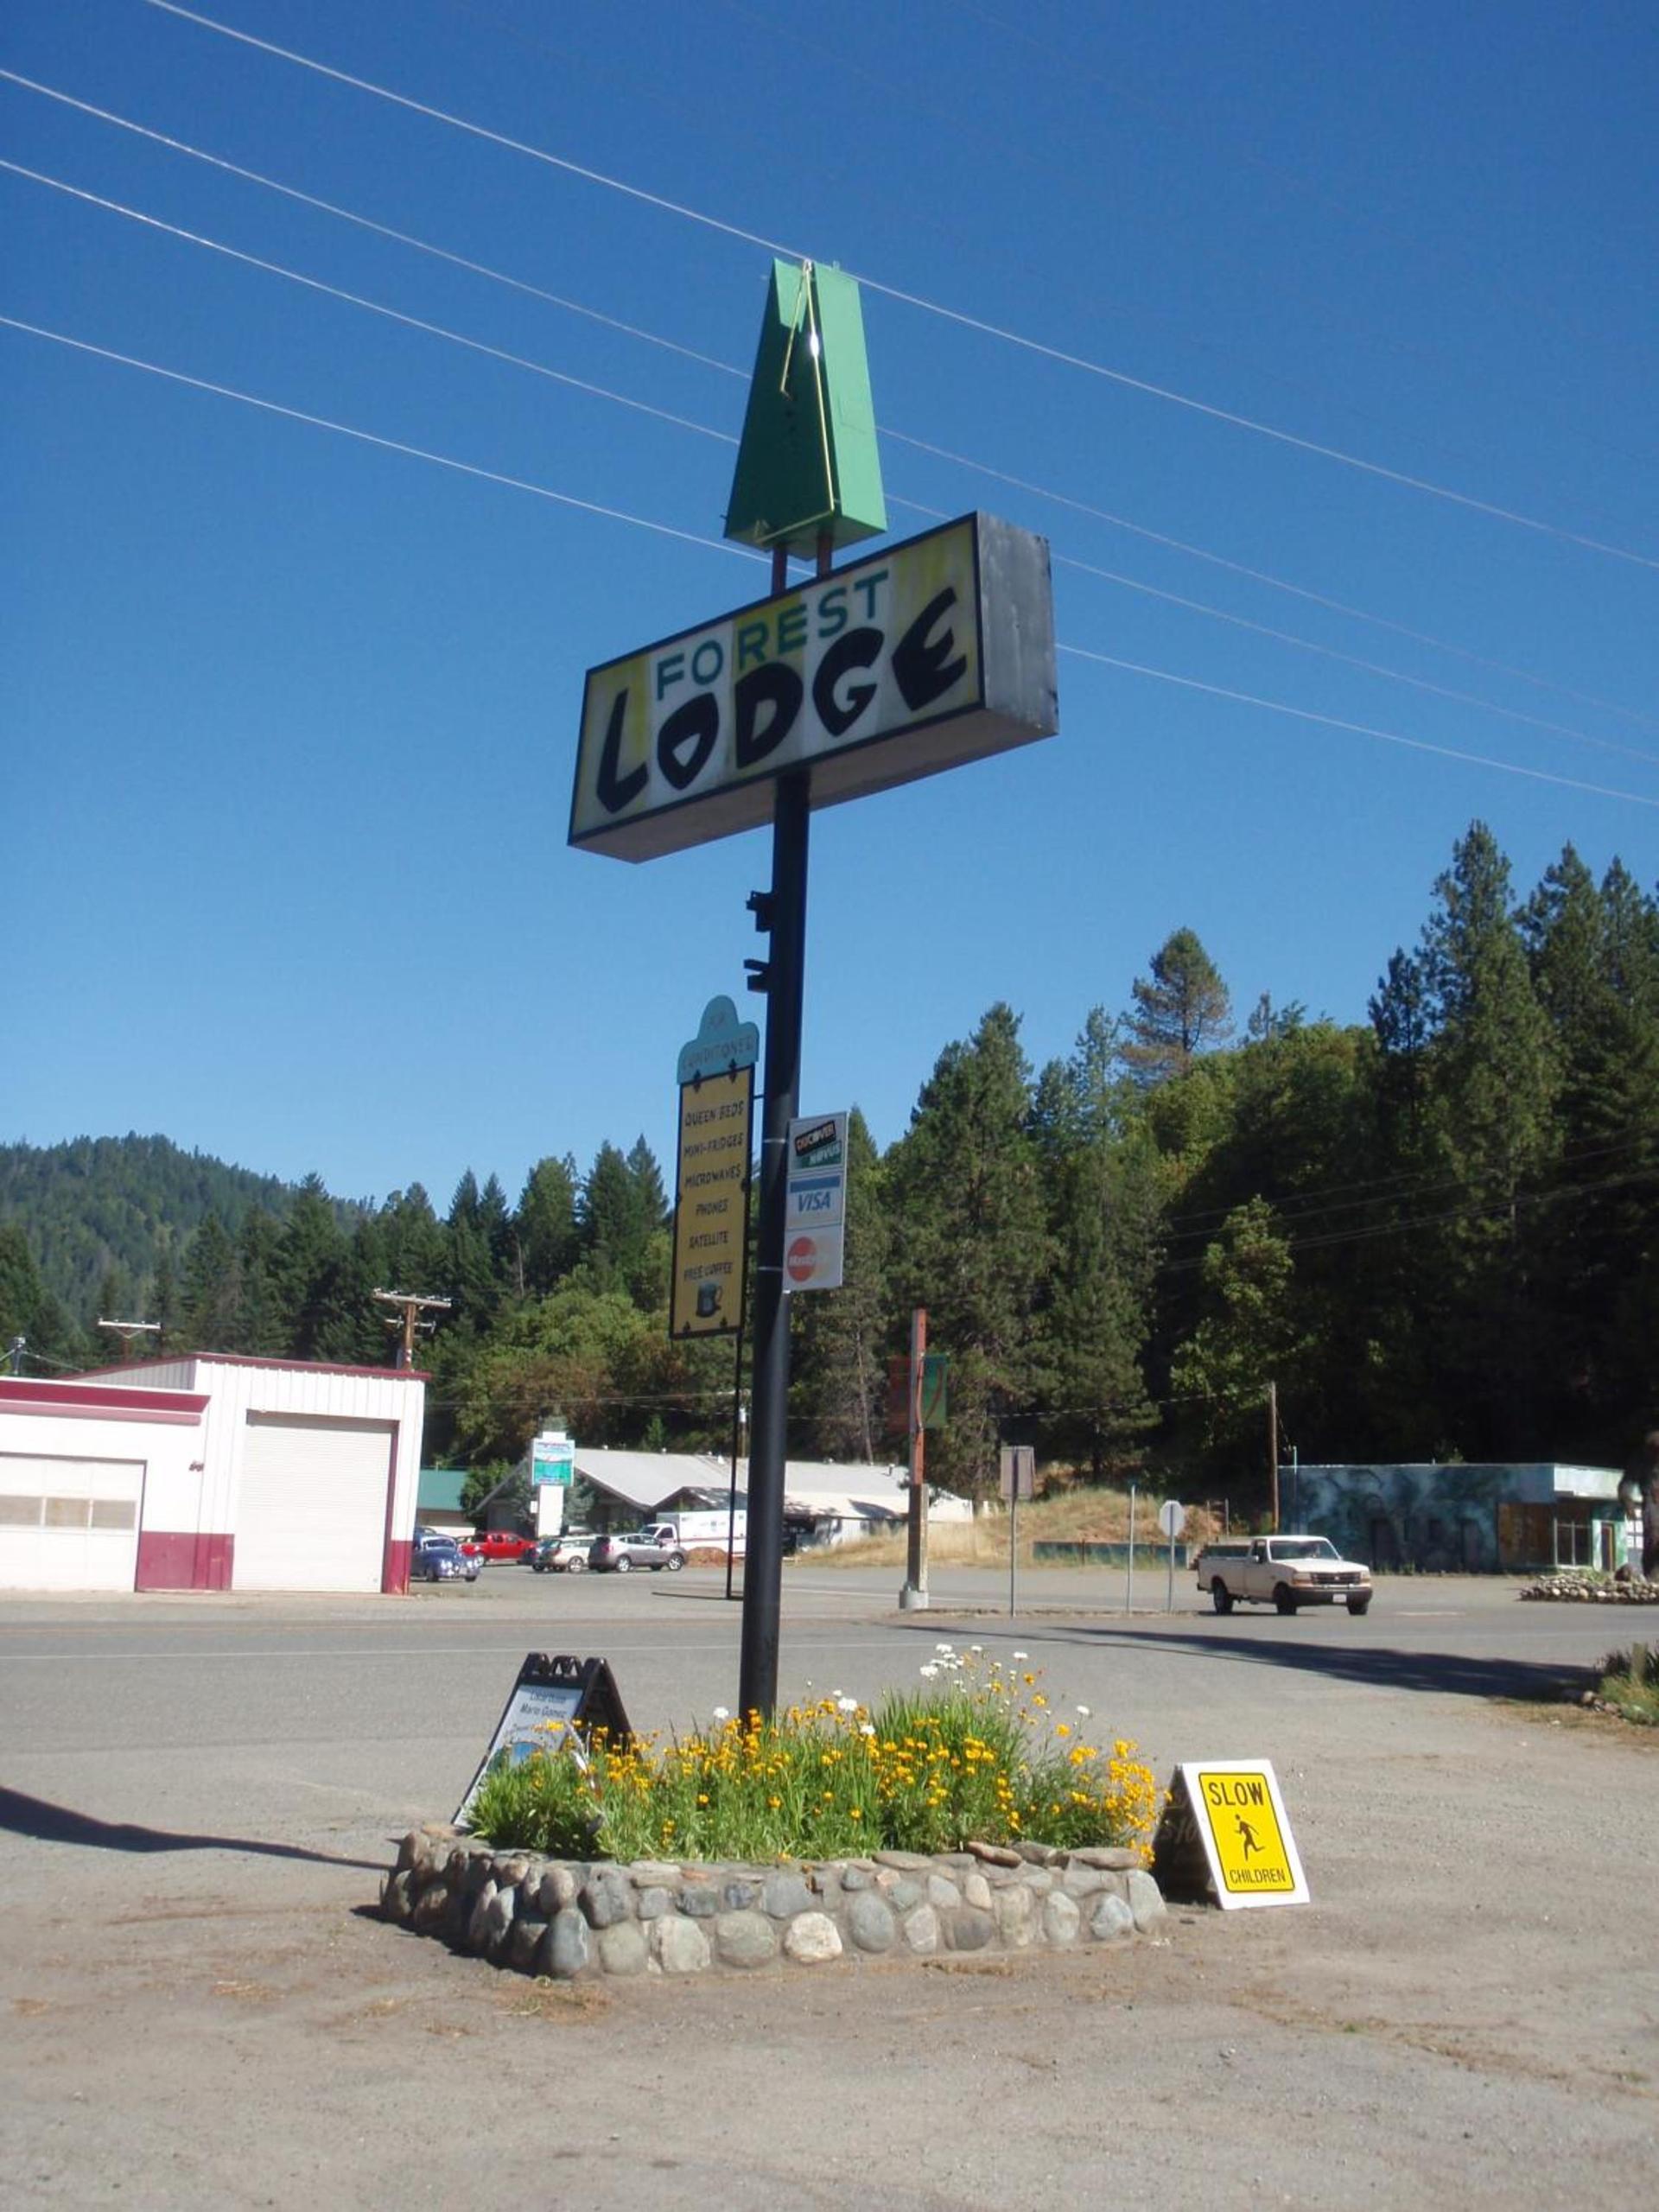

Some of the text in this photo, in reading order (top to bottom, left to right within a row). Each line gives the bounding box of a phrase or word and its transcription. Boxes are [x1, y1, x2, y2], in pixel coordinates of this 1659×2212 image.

[656, 568, 890, 702] FOREST
[595, 586, 969, 814] LODGE
[684, 1099, 745, 1128] QUEEN BEDS
[683, 1132, 745, 1158] MINI-FRIDGES
[684, 1163, 741, 1189] MICROWAVES
[695, 1198, 729, 1217] PHONES
[798, 1192, 832, 1212] VISA
[689, 1230, 729, 1249] SATELLITE
[683, 1262, 734, 1281] FREE COFFEE
[1208, 1781, 1264, 1807] SLOW
[1229, 1867, 1287, 1885] CHILDREN
